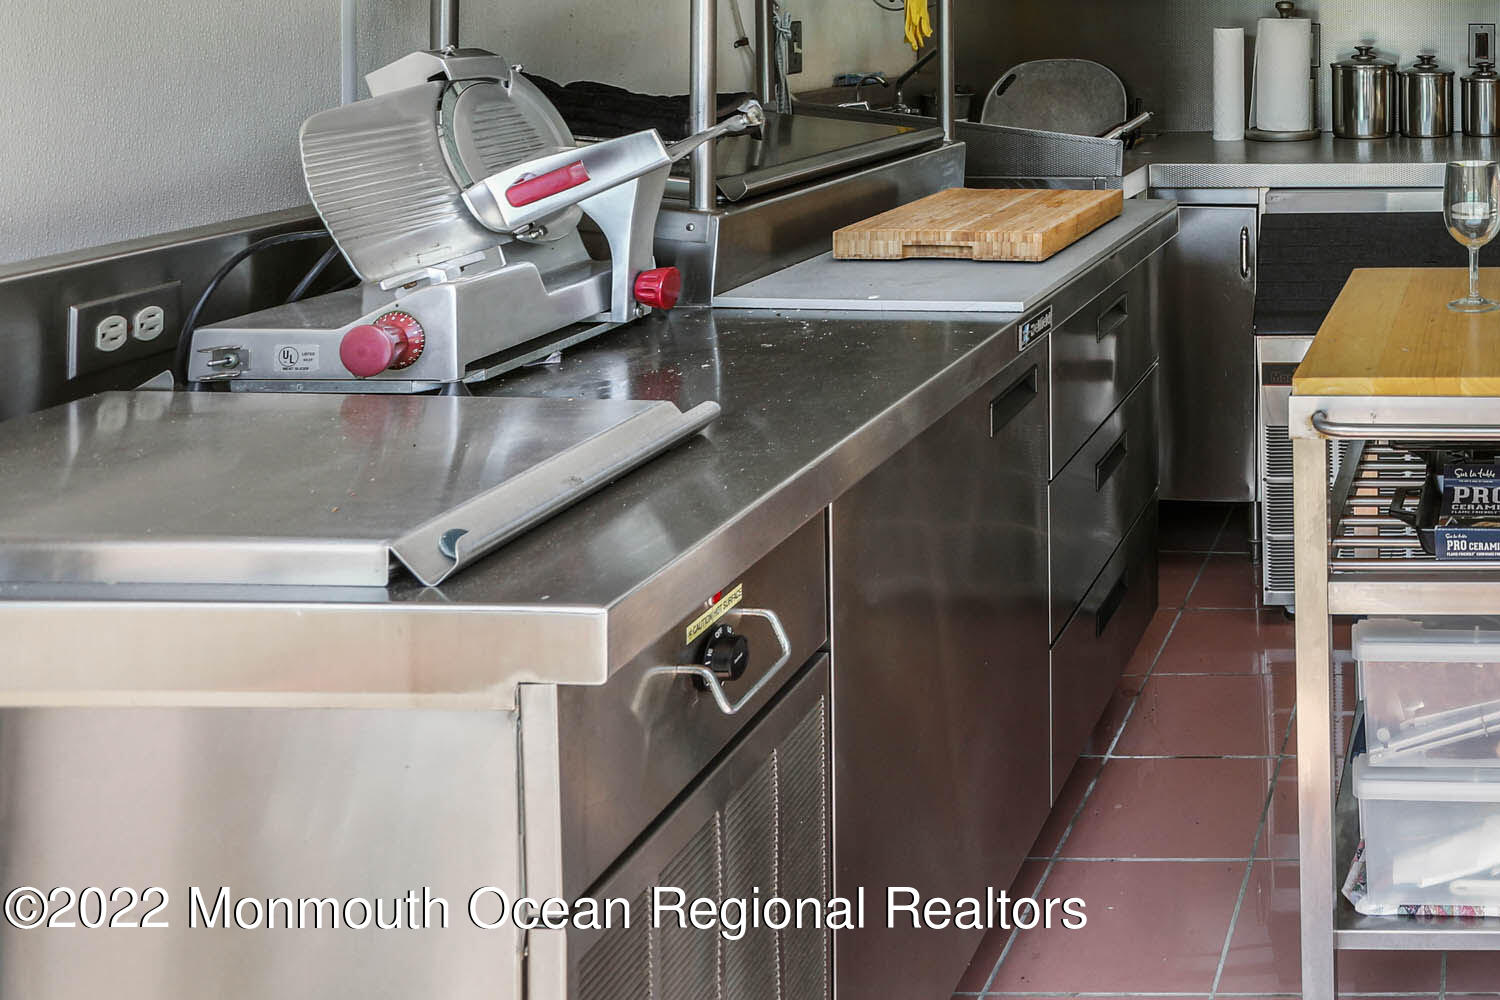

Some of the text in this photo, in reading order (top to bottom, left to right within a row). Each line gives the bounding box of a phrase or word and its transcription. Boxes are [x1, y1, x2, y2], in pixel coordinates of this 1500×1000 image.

[1454, 468, 1496, 479] Sur la table
[1446, 540, 1467, 551] PRO
